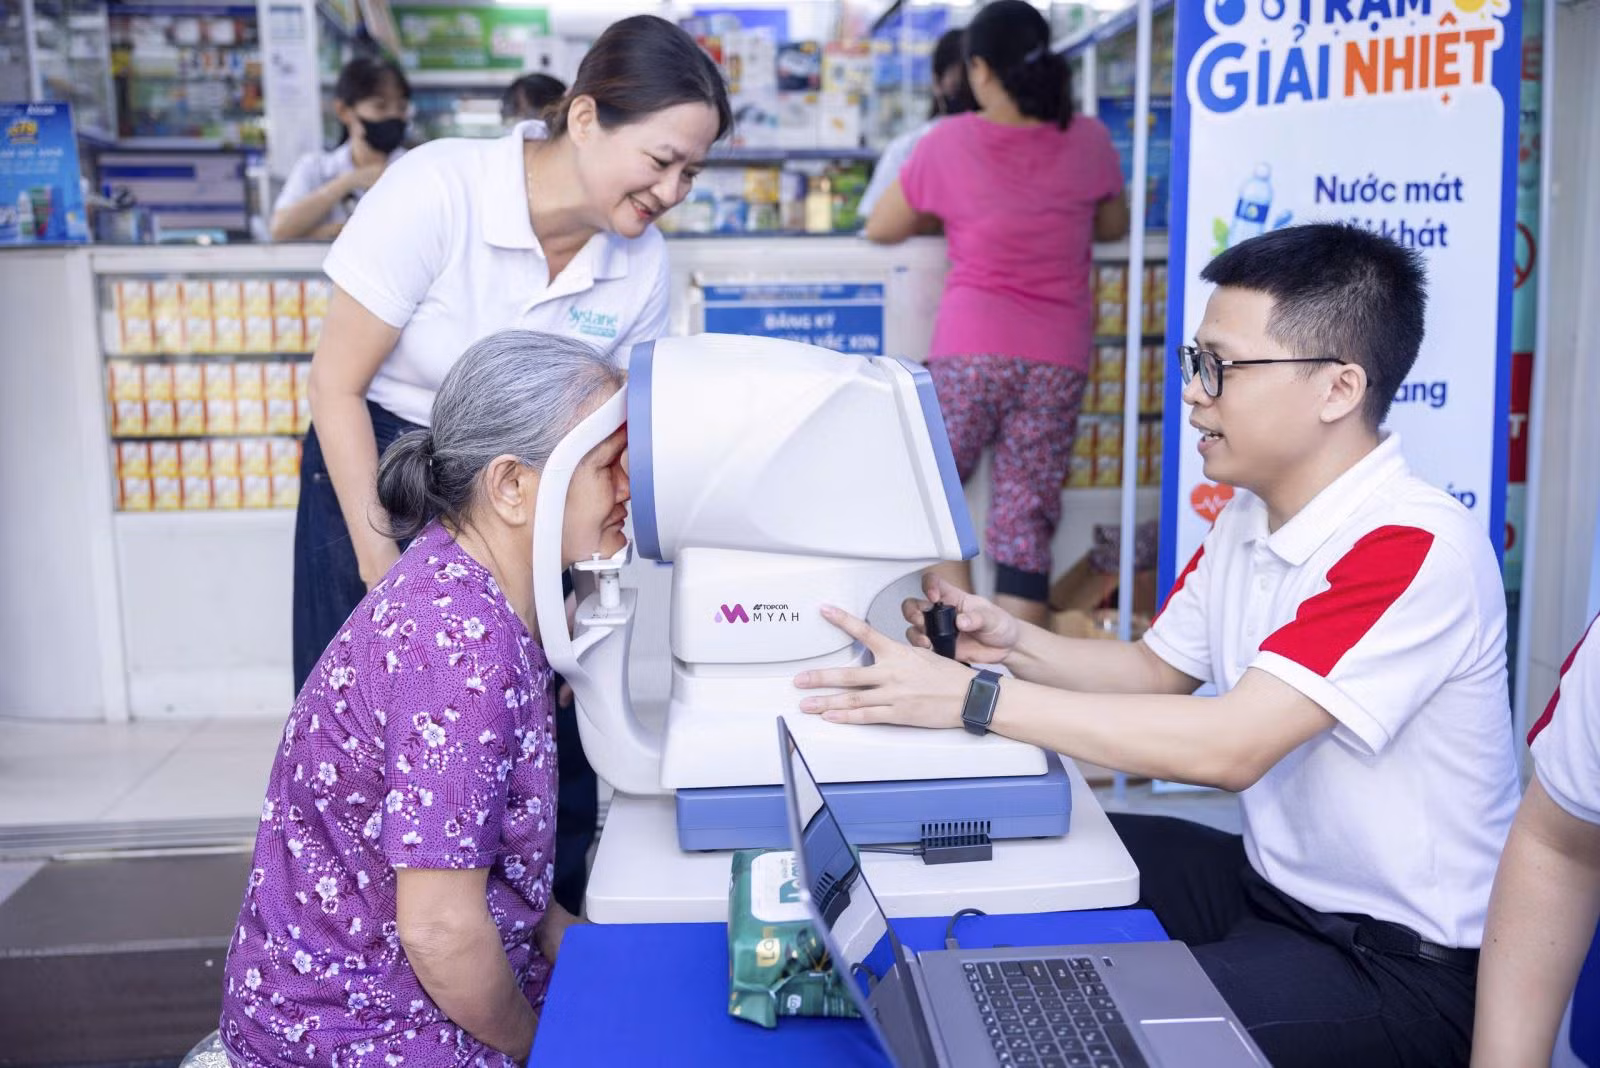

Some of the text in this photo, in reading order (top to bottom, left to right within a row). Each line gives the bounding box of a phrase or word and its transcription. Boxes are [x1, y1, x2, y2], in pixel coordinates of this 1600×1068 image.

[1197, 12, 1496, 113] GIẢI NHIỆT
[1315, 172, 1464, 203] Nước mát
[753, 612, 799, 622] MYAH
